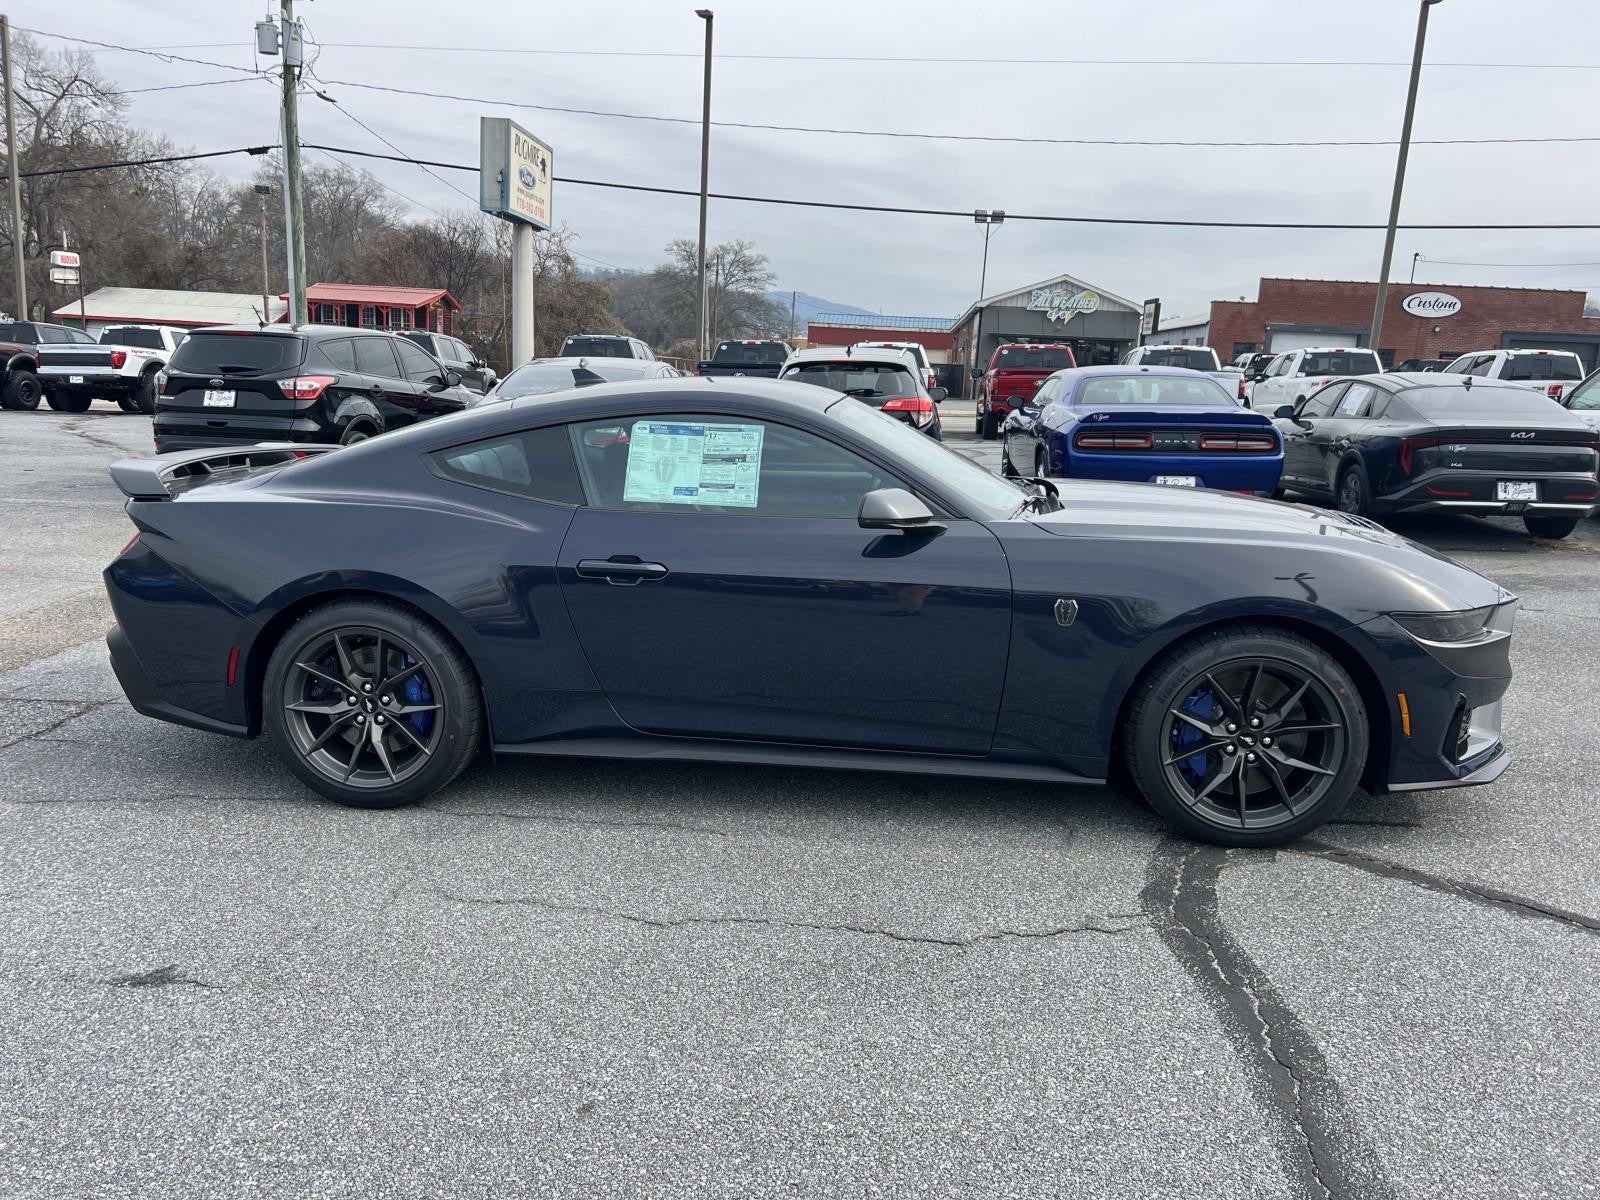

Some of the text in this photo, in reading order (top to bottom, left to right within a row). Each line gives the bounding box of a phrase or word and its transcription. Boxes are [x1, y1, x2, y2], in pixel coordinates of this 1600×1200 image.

[1033, 295, 1097, 310] ALL WEATHER
[1407, 296, 1458, 312] Custom
[1510, 431, 1536, 439] KIA
